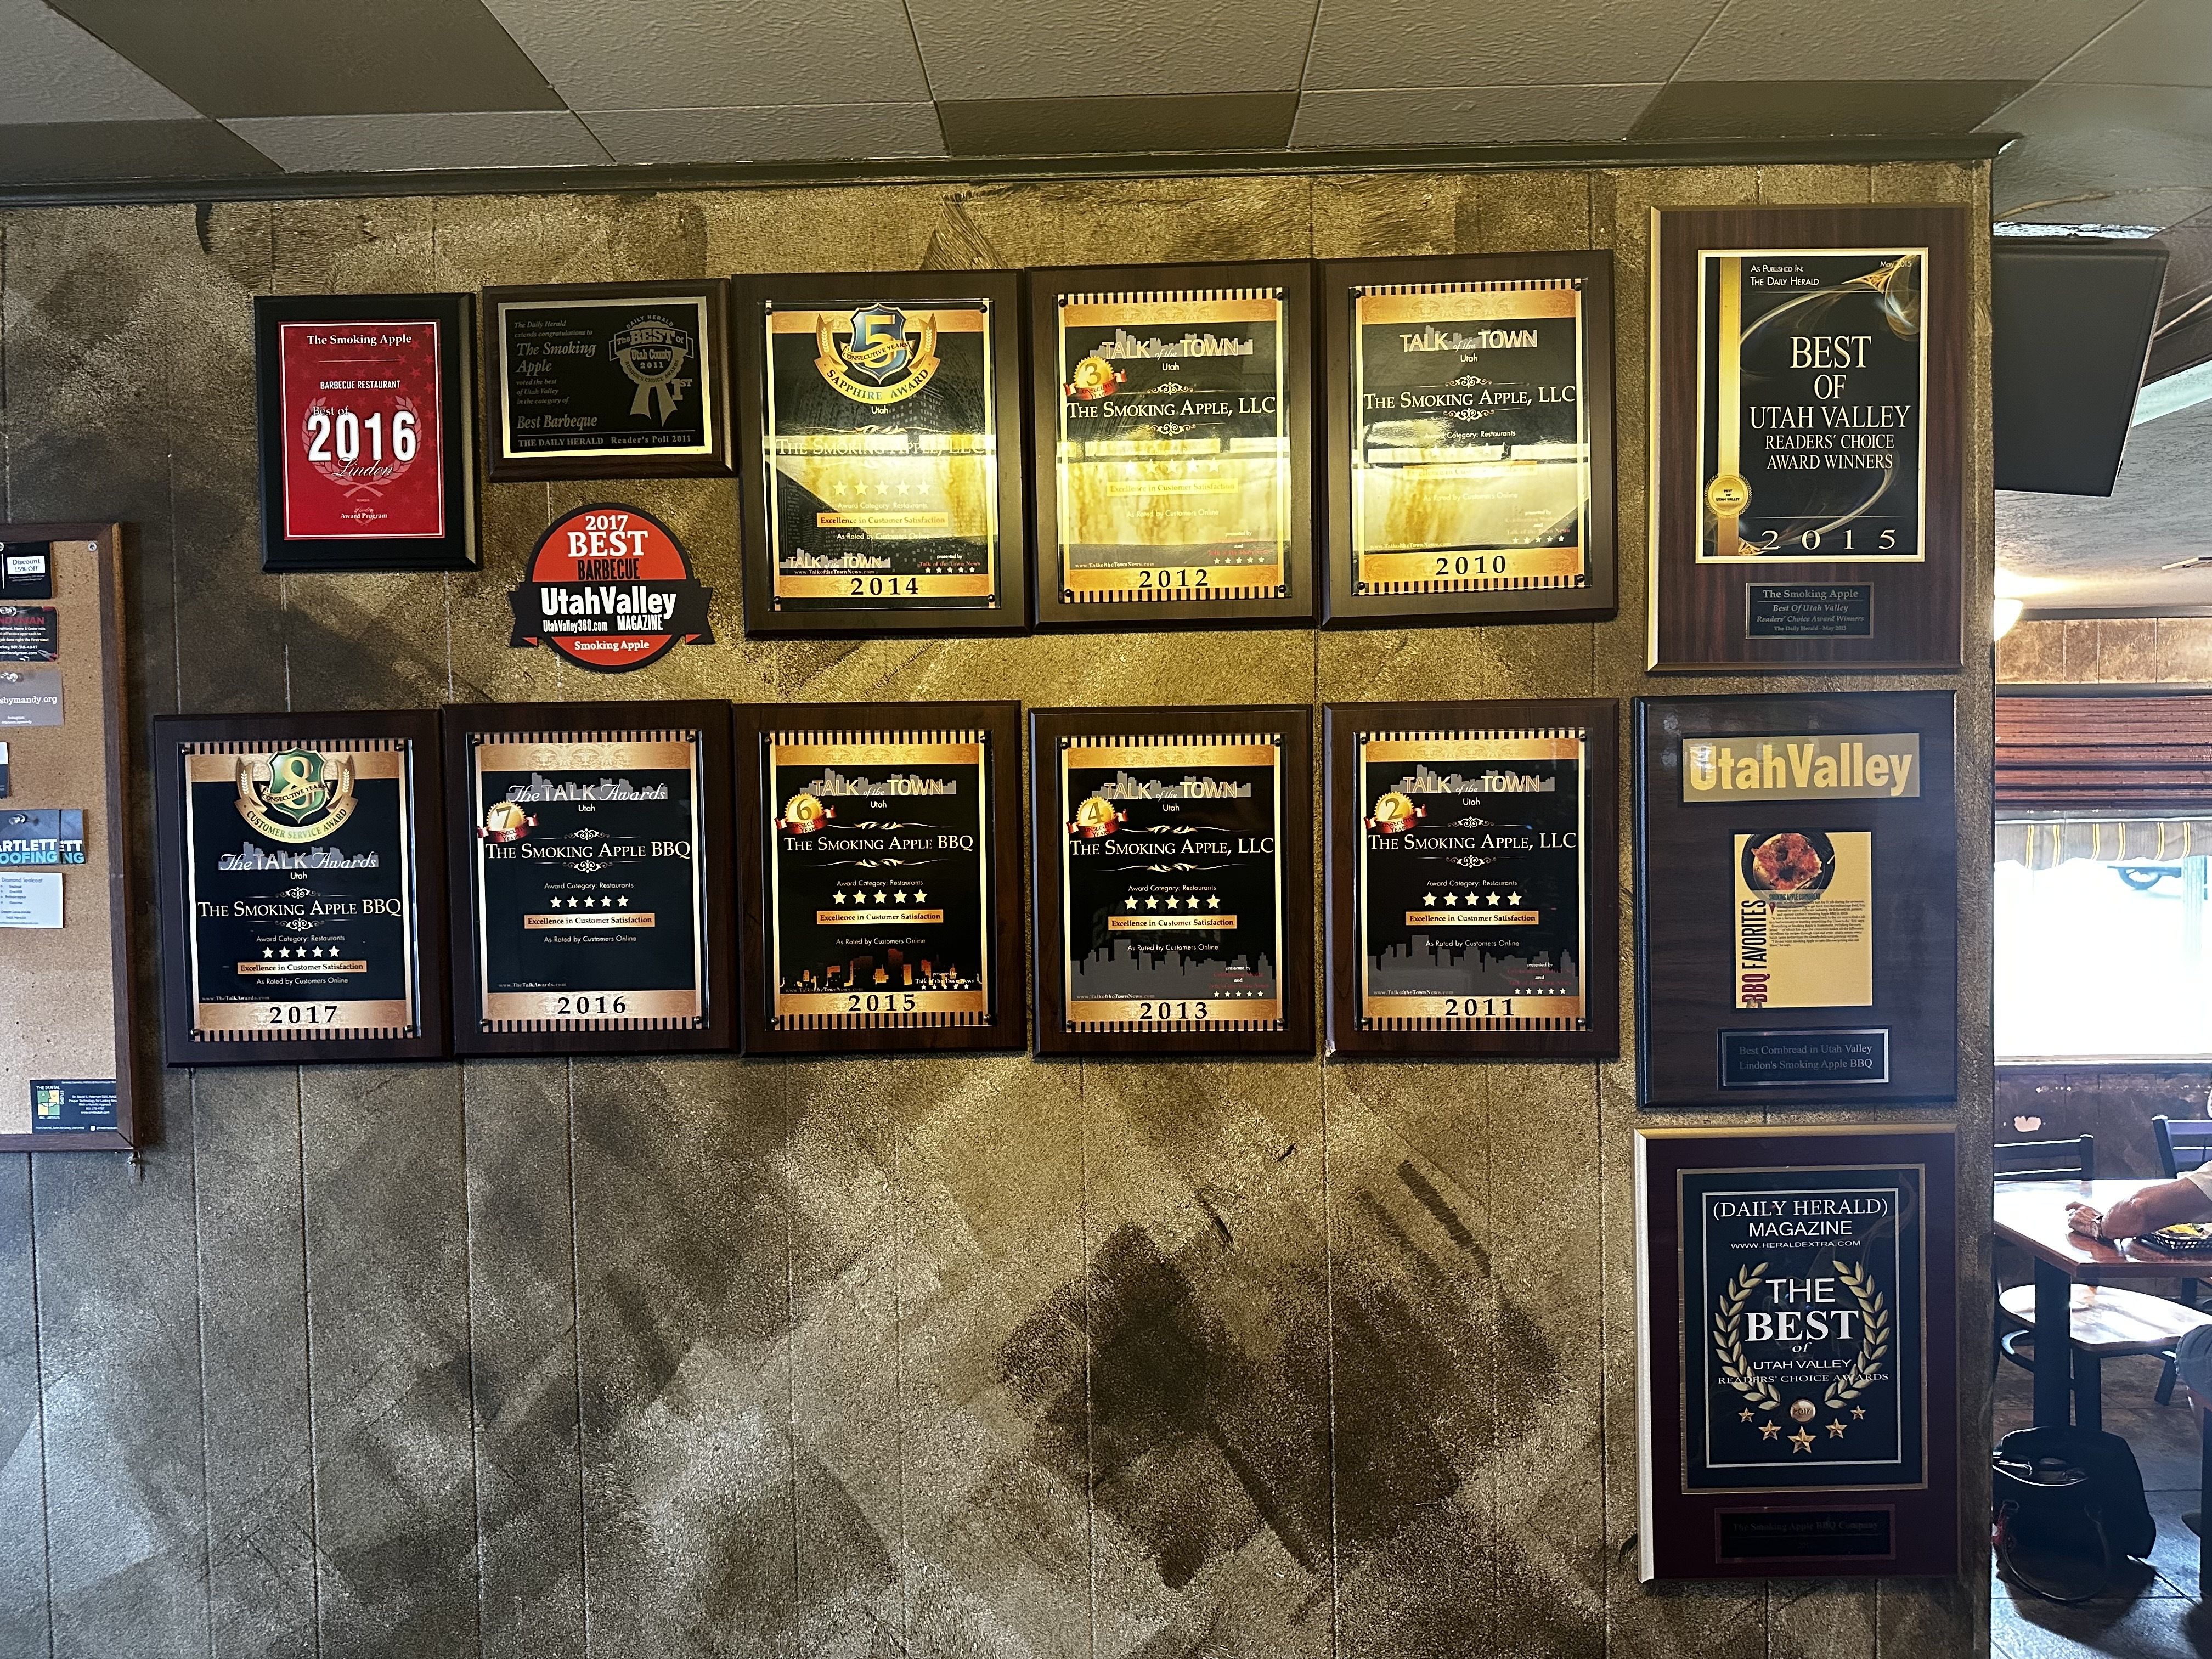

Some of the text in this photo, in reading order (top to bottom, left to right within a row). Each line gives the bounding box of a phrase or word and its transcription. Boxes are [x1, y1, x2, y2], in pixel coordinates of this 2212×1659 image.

[1751, 277, 1764, 285] THE
[1767, 277, 1787, 286] DAILY
[527, 321, 543, 329] Daily
[307, 334, 411, 346] The Smoking Apple
[617, 335, 630, 345] The
[630, 330, 675, 345] BEST
[865, 315, 896, 368] 5
[517, 341, 596, 357] The Smoking
[843, 341, 909, 362] CONSECUTIVE YEARS
[1102, 341, 1151, 359] TALK
[1180, 338, 1238, 357] TOWN
[1790, 336, 1871, 369] BEST
[516, 360, 552, 376] Apple
[1084, 363, 1102, 386] 3
[1162, 363, 1179, 371] Utah
[320, 380, 400, 390] BARBECUE RESTAURANT
[827, 369, 928, 400] SAPPHIRE AWARD
[1814, 374, 1847, 400] OF
[1364, 386, 1576, 409] THE SMOKING APPLE, LLC
[313, 405, 348, 416] Best of
[871, 406, 888, 414] Utah
[1067, 397, 1276, 419] THE SMOKING APPLE, LLC
[1750, 405, 1911, 429] UTAH VALLEY
[517, 414, 597, 431] Best Barbeque
[307, 410, 417, 462] 2016
[1841, 434, 1894, 449] CHOICE
[332, 457, 393, 476] Lindon
[1767, 454, 1892, 470] AWARD WINNERS
[585, 515, 628, 531] 2017
[568, 531, 648, 557] BEST
[578, 558, 640, 580] BARBECUE
[1436, 555, 1506, 575] 2010
[851, 577, 918, 595] 2014
[1139, 569, 1208, 588] 2012
[541, 586, 676, 619] UtahValley
[1763, 589, 1858, 600] The Smoking Apple
[1791, 605, 1801, 613] Of
[543, 615, 663, 633] UtahValley360.com MAGAZINE
[574, 640, 649, 652] Smoking Apple
[1690, 742, 1912, 796] UtahValley
[281, 756, 312, 809] 8
[496, 805, 512, 829] 7
[1087, 802, 1104, 825] 4
[1385, 798, 1403, 820] 2
[246, 809, 347, 839] CUSTOMER SERVICE AWARD
[486, 840, 691, 860] THE SMOKING APPLE BBQ
[784, 835, 974, 851] THE SMOKING APPLE BBQ
[1070, 838, 1273, 855] THE SMOKING APPLE, LLC
[1368, 832, 1576, 851] THE SMOKING APPLE, LLC
[221, 851, 377, 871] The TALK Awards
[198, 899, 402, 917] THE SMOKING APPLE BBQ
[1742, 900, 1770, 1002] BBQ FAVORITES
[557, 996, 625, 1014] 2016
[848, 994, 916, 1012] 2015
[1140, 1001, 1207, 1020] 2013
[1445, 998, 1515, 1017] 2011
[270, 1006, 337, 1024] 2017
[1761, 1045, 1807, 1054] Cornbread
[1810, 1045, 1818, 1053] in
[1821, 1045, 1842, 1053] Utah
[1844, 1044, 1872, 1054] Valley
[1740, 1059, 1872, 1070] Lindon's Smoking Apple BBQ
[1713, 1198, 1888, 1220] (DAILY HERALD)
[1750, 1221, 1852, 1237] MAGAZINE
[1731, 1240, 1861, 1249] WWW.HERALDEXTRA.COM
[1765, 1278, 1835, 1304] THE
[1744, 1310, 1859, 1341] BEST
[1792, 1342, 1812, 1352] of
[1753, 1359, 1852, 1370] UTAH VALLEY
